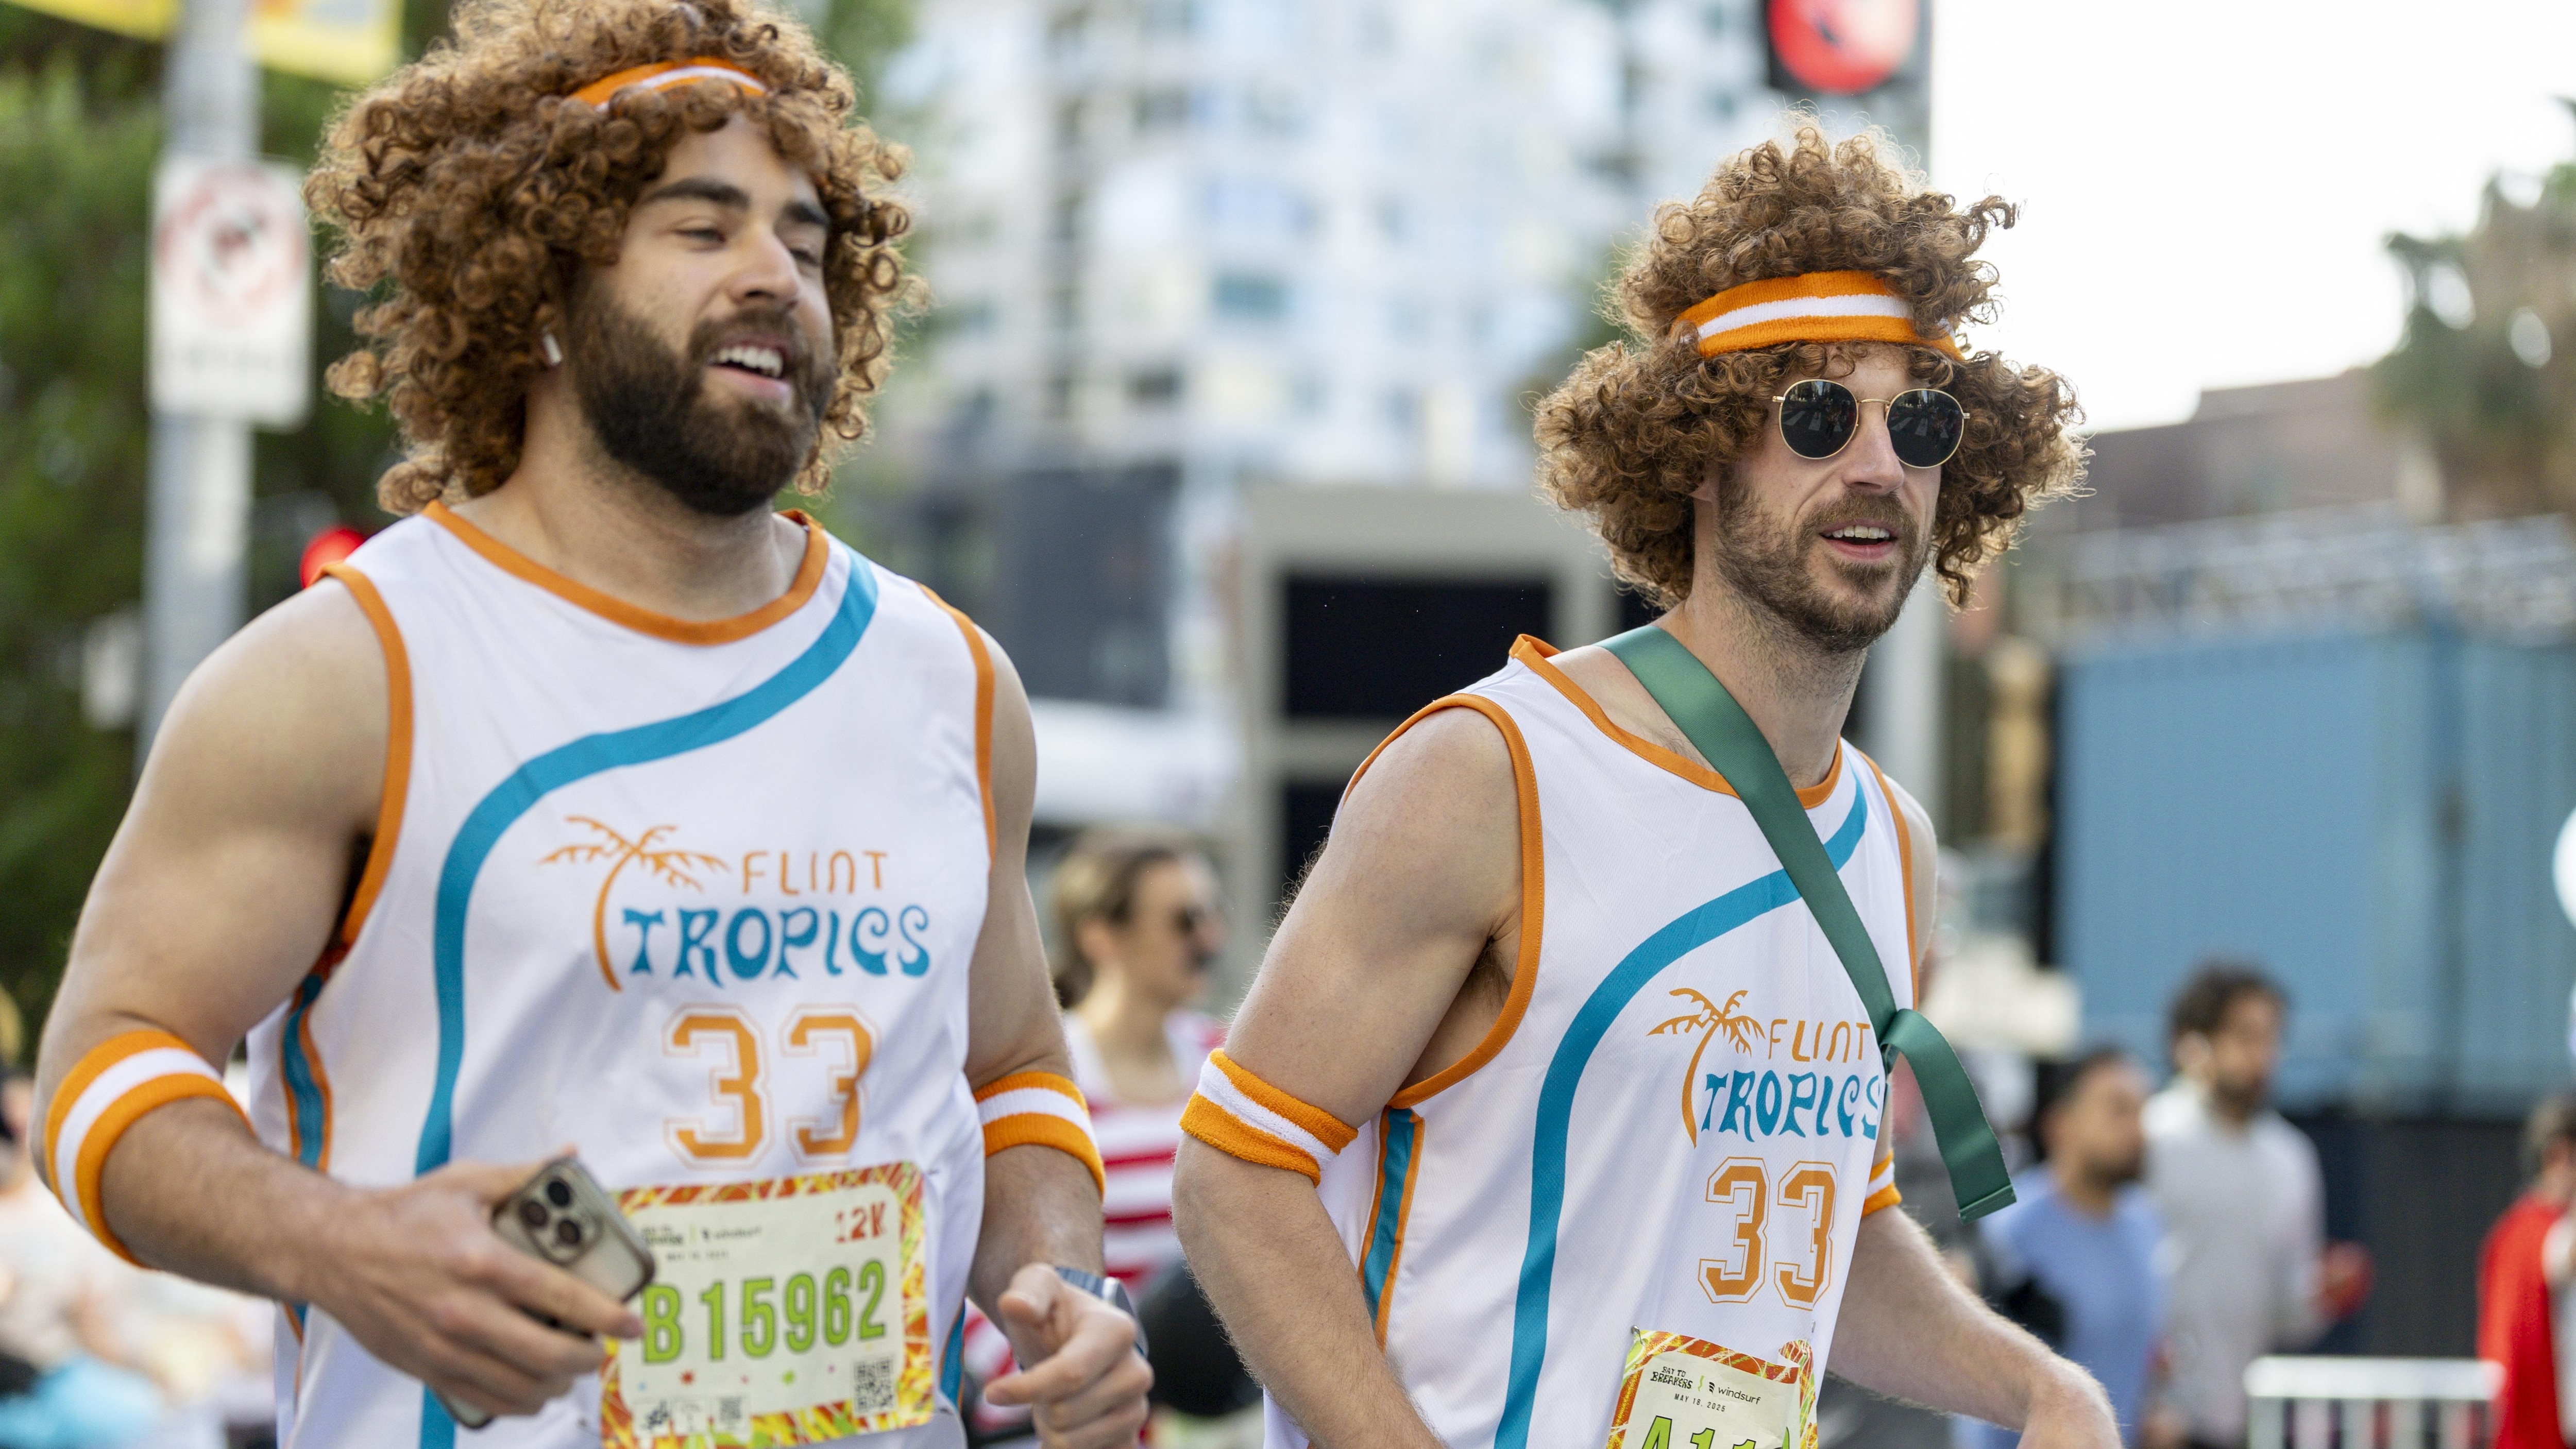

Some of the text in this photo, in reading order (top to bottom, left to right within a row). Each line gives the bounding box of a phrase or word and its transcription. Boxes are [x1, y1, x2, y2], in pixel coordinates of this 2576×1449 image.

[743, 850, 888, 895] FLINT
[622, 905, 929, 988] TROPICS
[1768, 1019, 1871, 1063] FLINT
[663, 1004, 882, 1170] 33
[1701, 1070, 1880, 1142] TROPICS
[836, 1201, 887, 1243] 12K
[1698, 1156, 1838, 1311] 33
[642, 1260, 885, 1364] B15962
[1650, 1371, 1693, 1389] BREAKERS
[1662, 1366, 1675, 1375] BAY
[1674, 1393, 1689, 1403] MAY
[1707, 1402, 1725, 1412] 2025
[1718, 1387, 1761, 1405] windsurf
